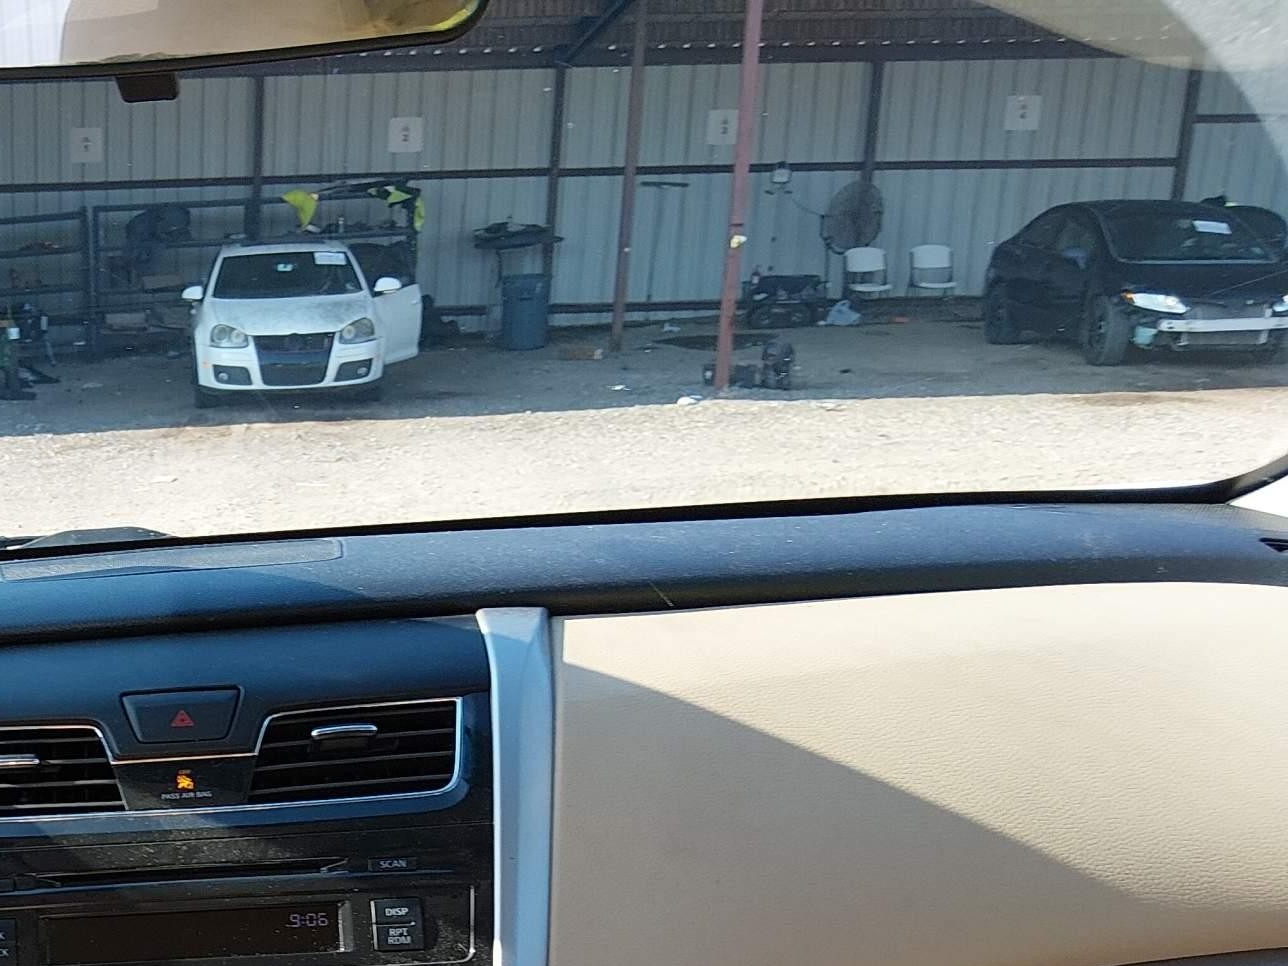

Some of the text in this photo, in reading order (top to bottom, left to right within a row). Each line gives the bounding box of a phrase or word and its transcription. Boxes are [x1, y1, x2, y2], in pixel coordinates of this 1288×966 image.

[378, 860, 407, 869] SCAN
[385, 908, 409, 917] DISP
[288, 913, 329, 928] 9:06
[388, 928, 409, 937] RPT
[387, 936, 411, 945] RDM
